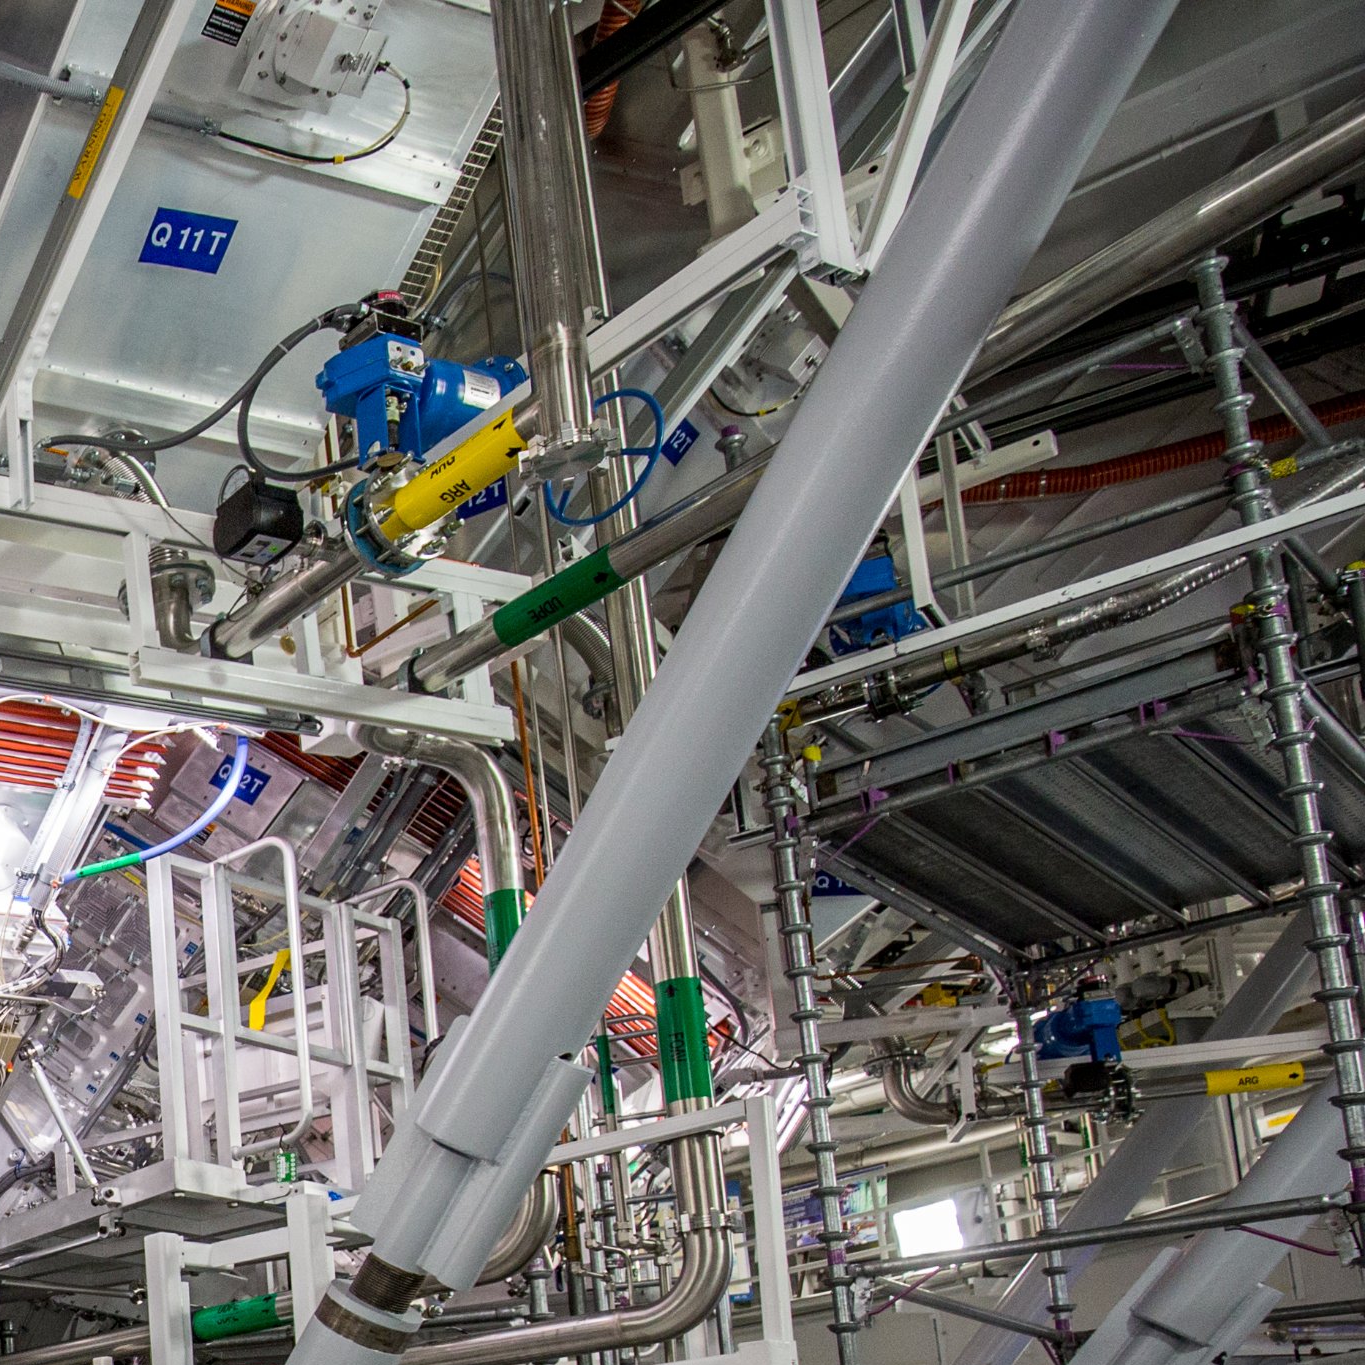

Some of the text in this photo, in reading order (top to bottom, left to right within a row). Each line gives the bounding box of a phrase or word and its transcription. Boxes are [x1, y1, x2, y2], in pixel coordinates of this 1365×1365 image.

[439, 479, 472, 504] ARG
[527, 596, 565, 624] UDPE
[1237, 1076, 1259, 1086] ARG
